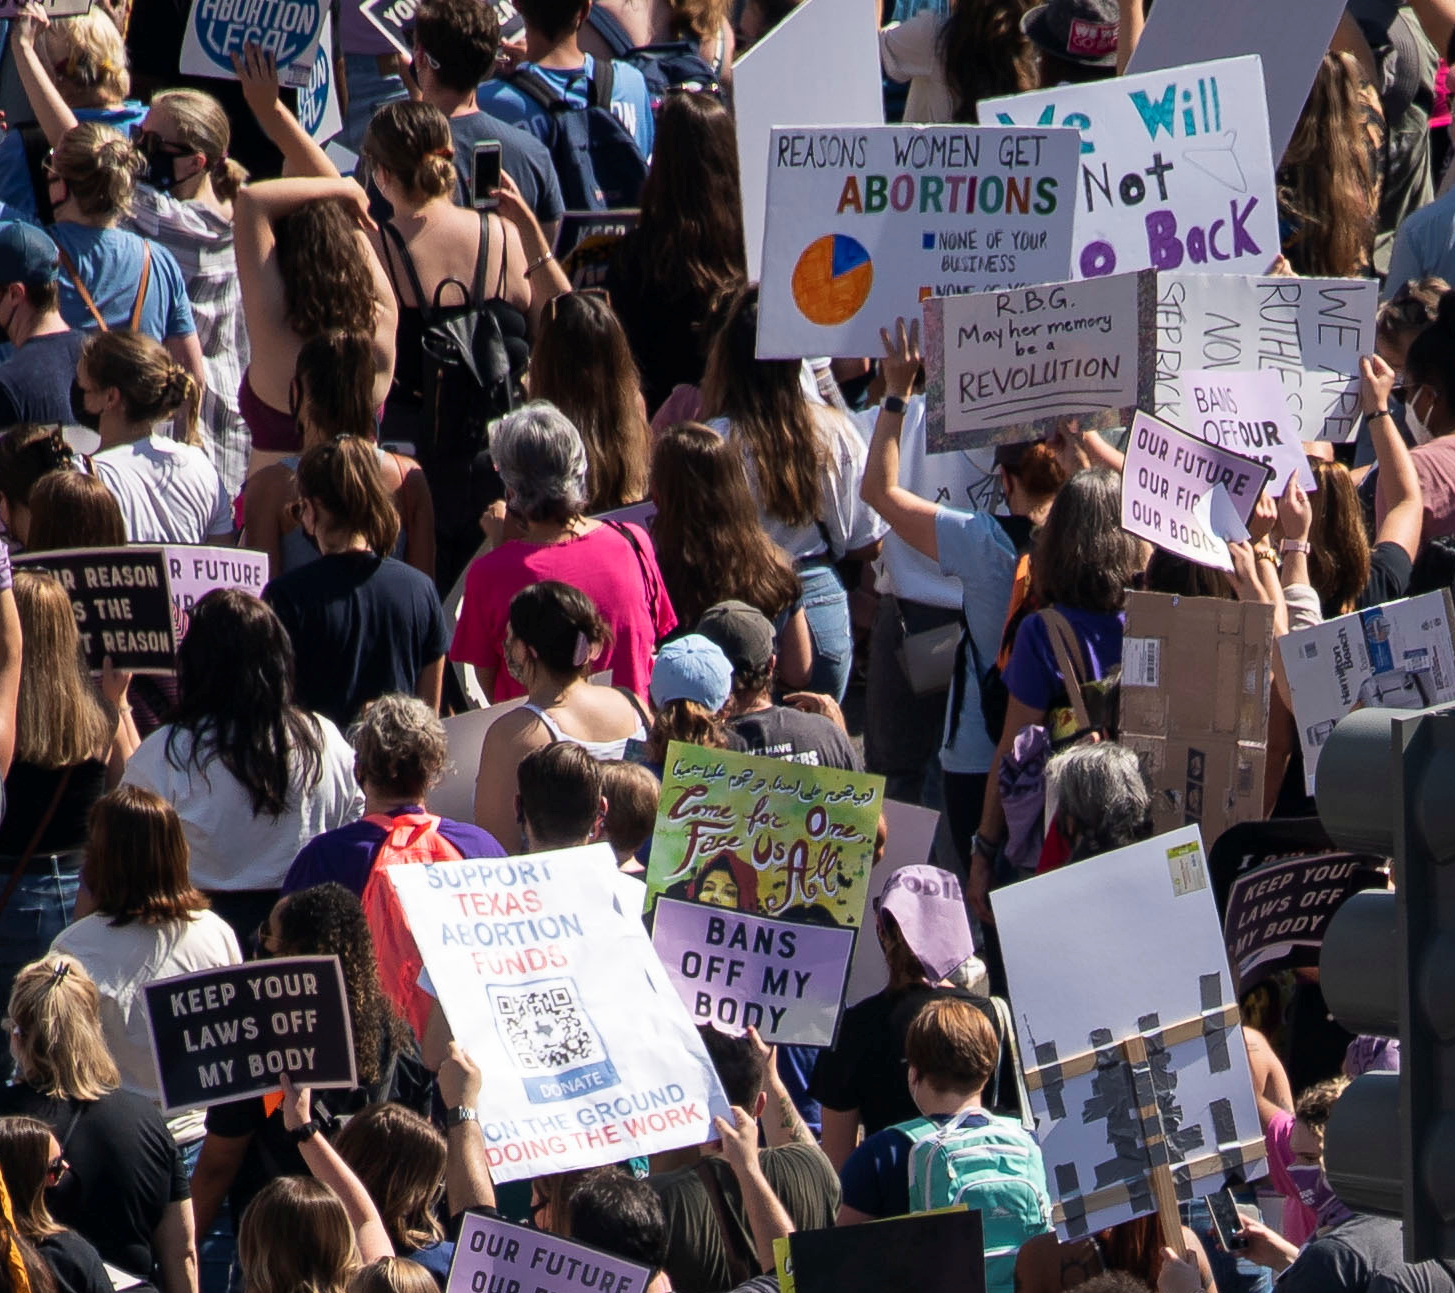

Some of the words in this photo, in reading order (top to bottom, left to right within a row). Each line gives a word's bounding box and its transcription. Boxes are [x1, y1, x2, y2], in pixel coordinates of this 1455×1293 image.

[777, 136, 867, 168] REASONS
[892, 135, 980, 168] WOMEN
[999, 135, 1048, 167] GET
[837, 174, 1058, 215] ABORTIONS
[938, 231, 977, 250] NONE
[986, 231, 1004, 250] OF
[1012, 230, 1048, 250] YOUR
[940, 255, 1017, 273] BUSINESS
[995, 287, 1076, 317] R.B.G.
[957, 323, 1004, 348] May
[1007, 321, 1043, 338] her
[1048, 315, 1112, 336] memory
[1014, 340, 1037, 356] be
[1045, 342, 1056, 352] a
[959, 356, 1121, 403] REVOLUTION
[427, 860, 553, 889] SUPPORT
[453, 890, 542, 917] TEXAS
[441, 915, 583, 947] ABORTION
[472, 946, 567, 977] FUNDS
[540, 1073, 603, 1098] DONATE
[485, 1126, 517, 1141] ON
[522, 1114, 570, 1134] THE
[577, 1084, 685, 1125] GROUND
[486, 1137, 566, 1166] DOING
[572, 1126, 621, 1149] THE
[623, 1104, 703, 1138] WORK
